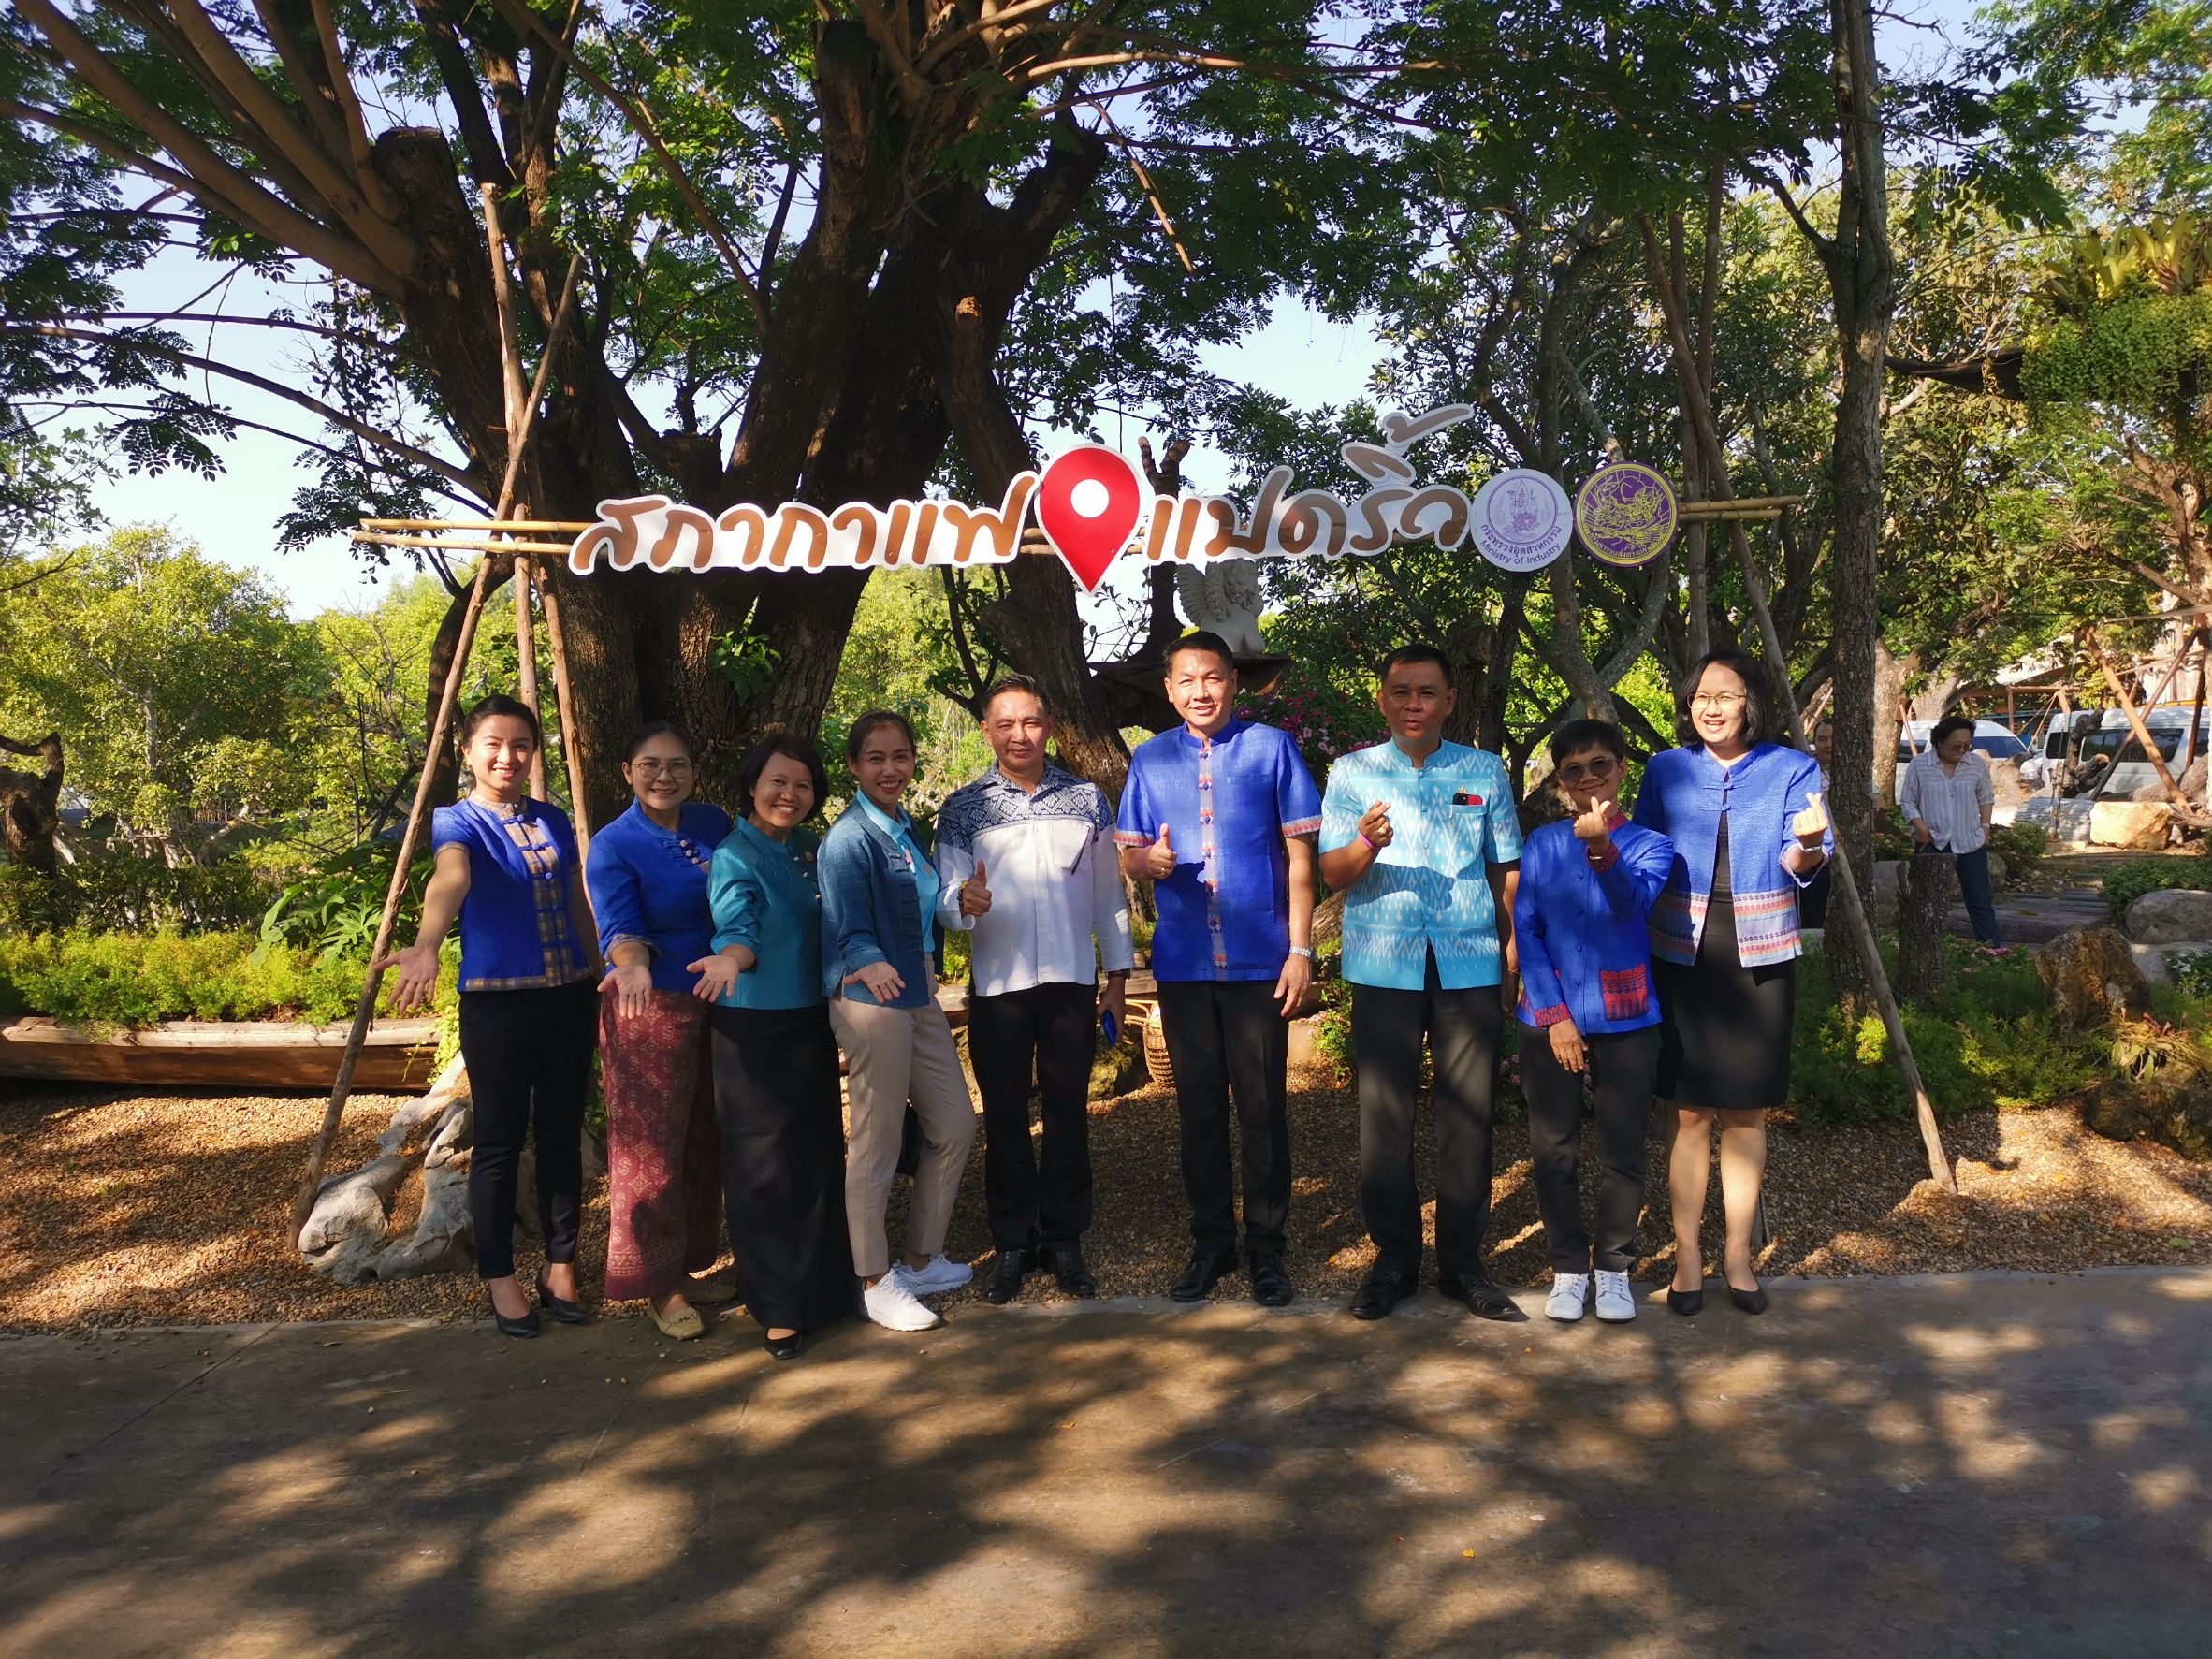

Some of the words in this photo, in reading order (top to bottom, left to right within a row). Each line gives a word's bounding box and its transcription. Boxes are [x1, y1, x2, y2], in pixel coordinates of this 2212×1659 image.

[572, 473, 1039, 572] สภากาแฟ
[1145, 404, 1474, 561] แปดริ้ว
[1480, 540, 1512, 564] Ministry
[1527, 543, 1561, 564] Industry
